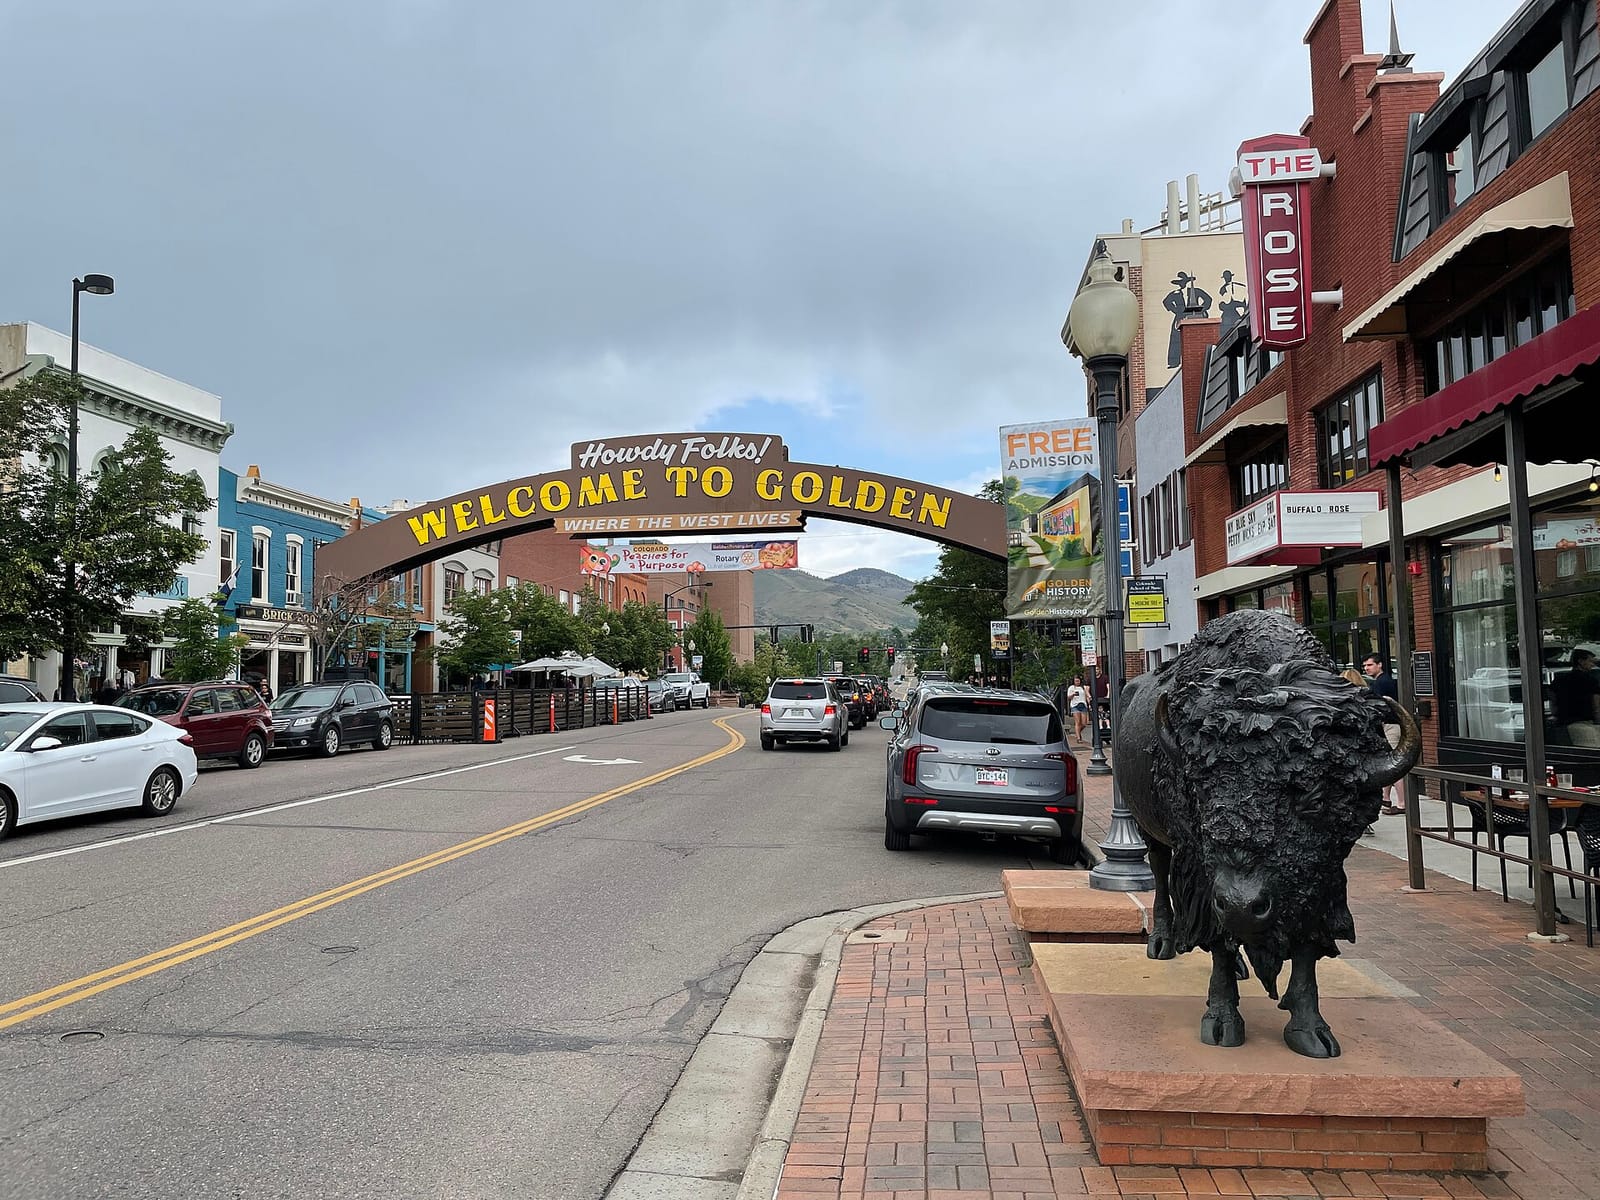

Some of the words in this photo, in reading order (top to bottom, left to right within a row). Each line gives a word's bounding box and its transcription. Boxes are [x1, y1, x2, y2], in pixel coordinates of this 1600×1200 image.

[1244, 154, 1315, 177] THE
[1262, 192, 1299, 331] ROSE
[1007, 427, 1092, 457] FREE
[578, 437, 677, 470] Howdy
[681, 435, 772, 465] Folks!
[1008, 453, 1093, 470] ADMISSION
[406, 467, 647, 545] WELCOME
[665, 465, 734, 498] TO
[755, 468, 953, 529] GOLDEN
[1286, 505, 1322, 514] BUFFALO
[564, 517, 630, 531] WHERE
[637, 516, 672, 529] THE
[679, 514, 732, 528] WEST
[737, 512, 791, 526] LIVES
[1247, 510, 1256, 525] SKY
[1268, 515, 1276, 530] SAT
[623, 549, 668, 561] Peaches
[670, 549, 689, 559] for
[715, 555, 740, 563] Rotary
[639, 560, 685, 571] Purpose
[1047, 579, 1092, 587] GOLDEN
[1047, 587, 1092, 596] HISTORY
[262, 608, 293, 621] BRICK
[1024, 608, 1088, 616] GoldenHistory.org
